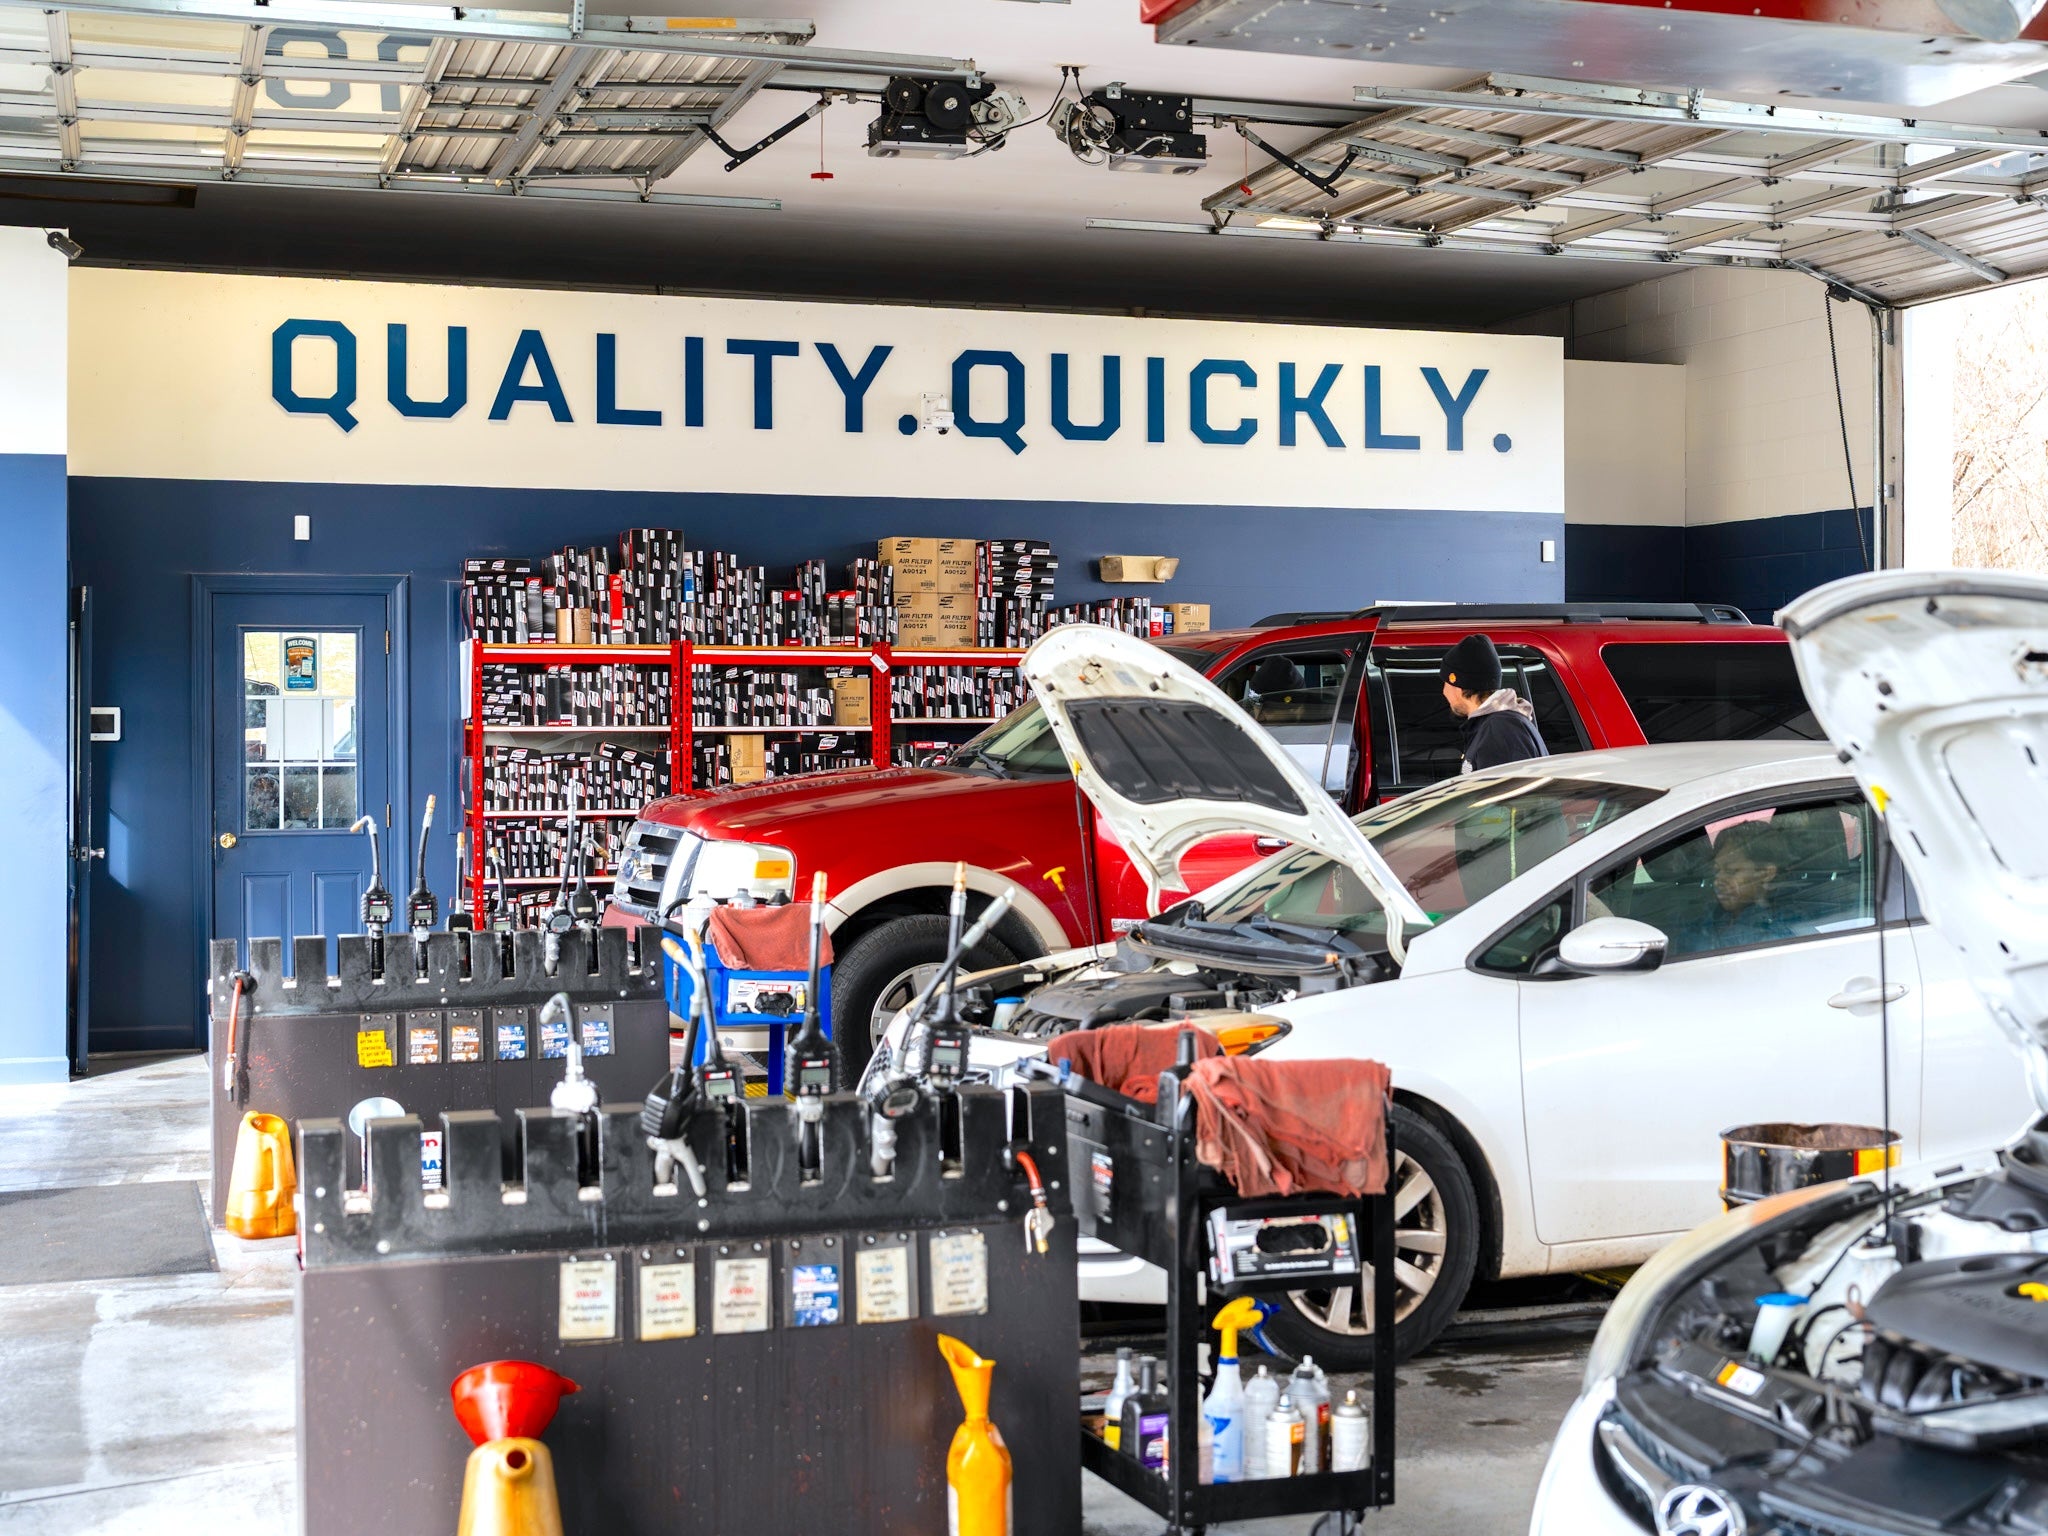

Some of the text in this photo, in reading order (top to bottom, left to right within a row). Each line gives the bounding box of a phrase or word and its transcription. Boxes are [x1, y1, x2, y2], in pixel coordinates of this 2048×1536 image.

[272, 319, 1512, 455] QUALITY. QUICKLY.
[898, 558, 933, 566] AIR FILTER
